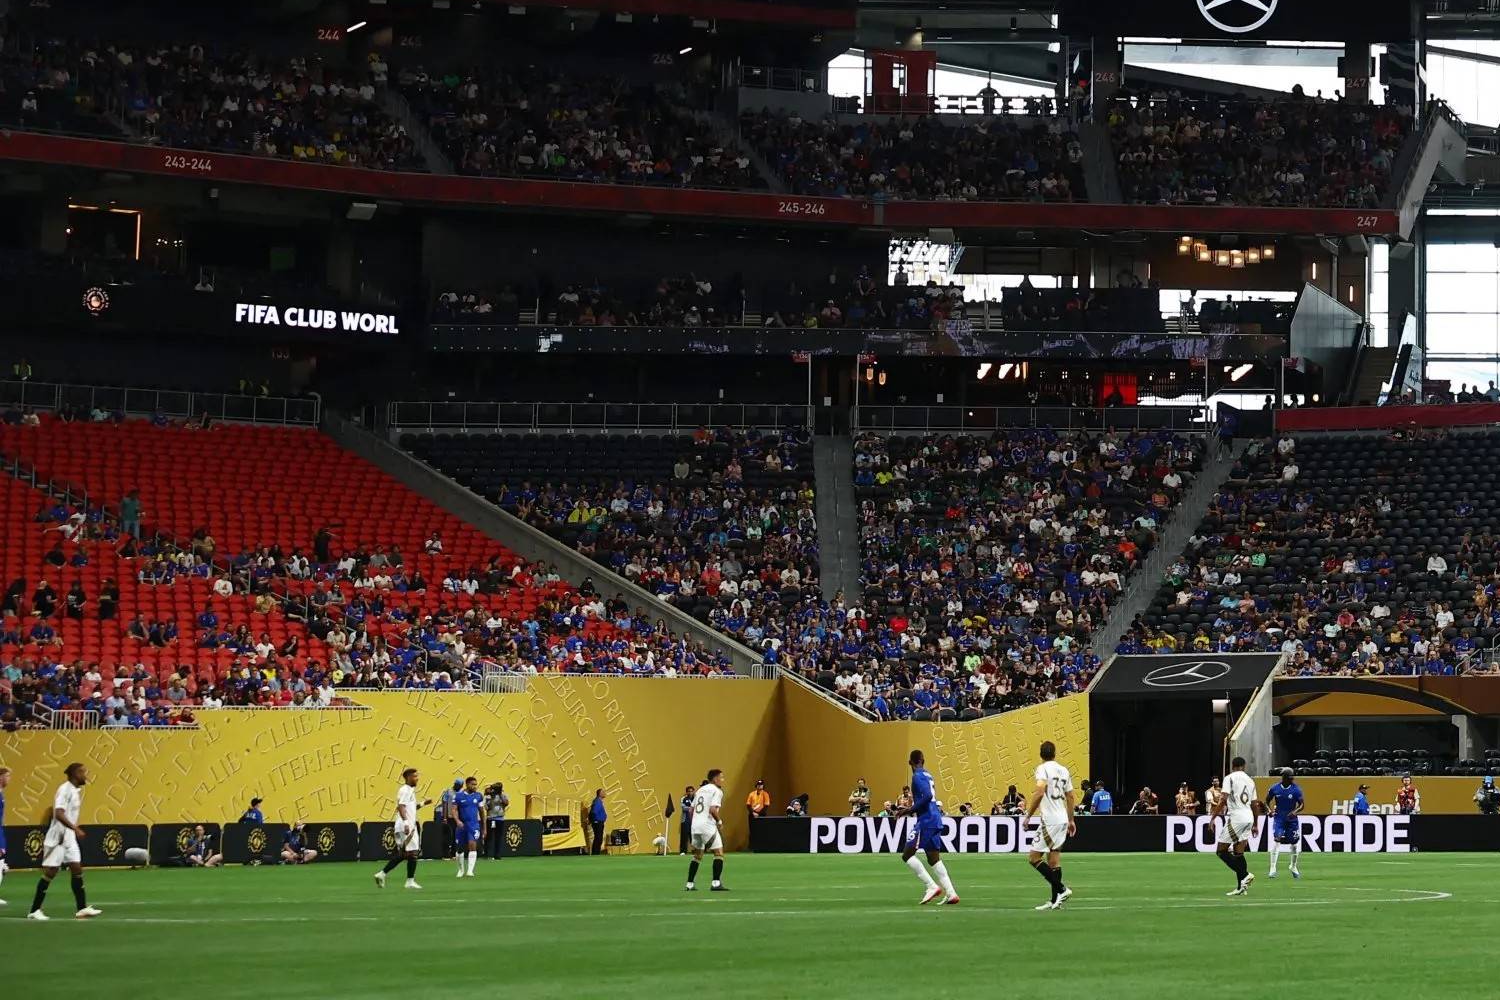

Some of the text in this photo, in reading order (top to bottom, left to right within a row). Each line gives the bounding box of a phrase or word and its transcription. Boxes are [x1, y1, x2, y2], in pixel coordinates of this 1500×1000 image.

[165, 156, 212, 171] 243-244
[778, 202, 826, 216] 245-246
[1356, 216, 1378, 228] 247
[235, 302, 399, 334] FIFA CLUB WORL
[695, 795, 705, 814] 8
[1239, 786, 1249, 805] 6
[810, 816, 1043, 853] POWRADE
